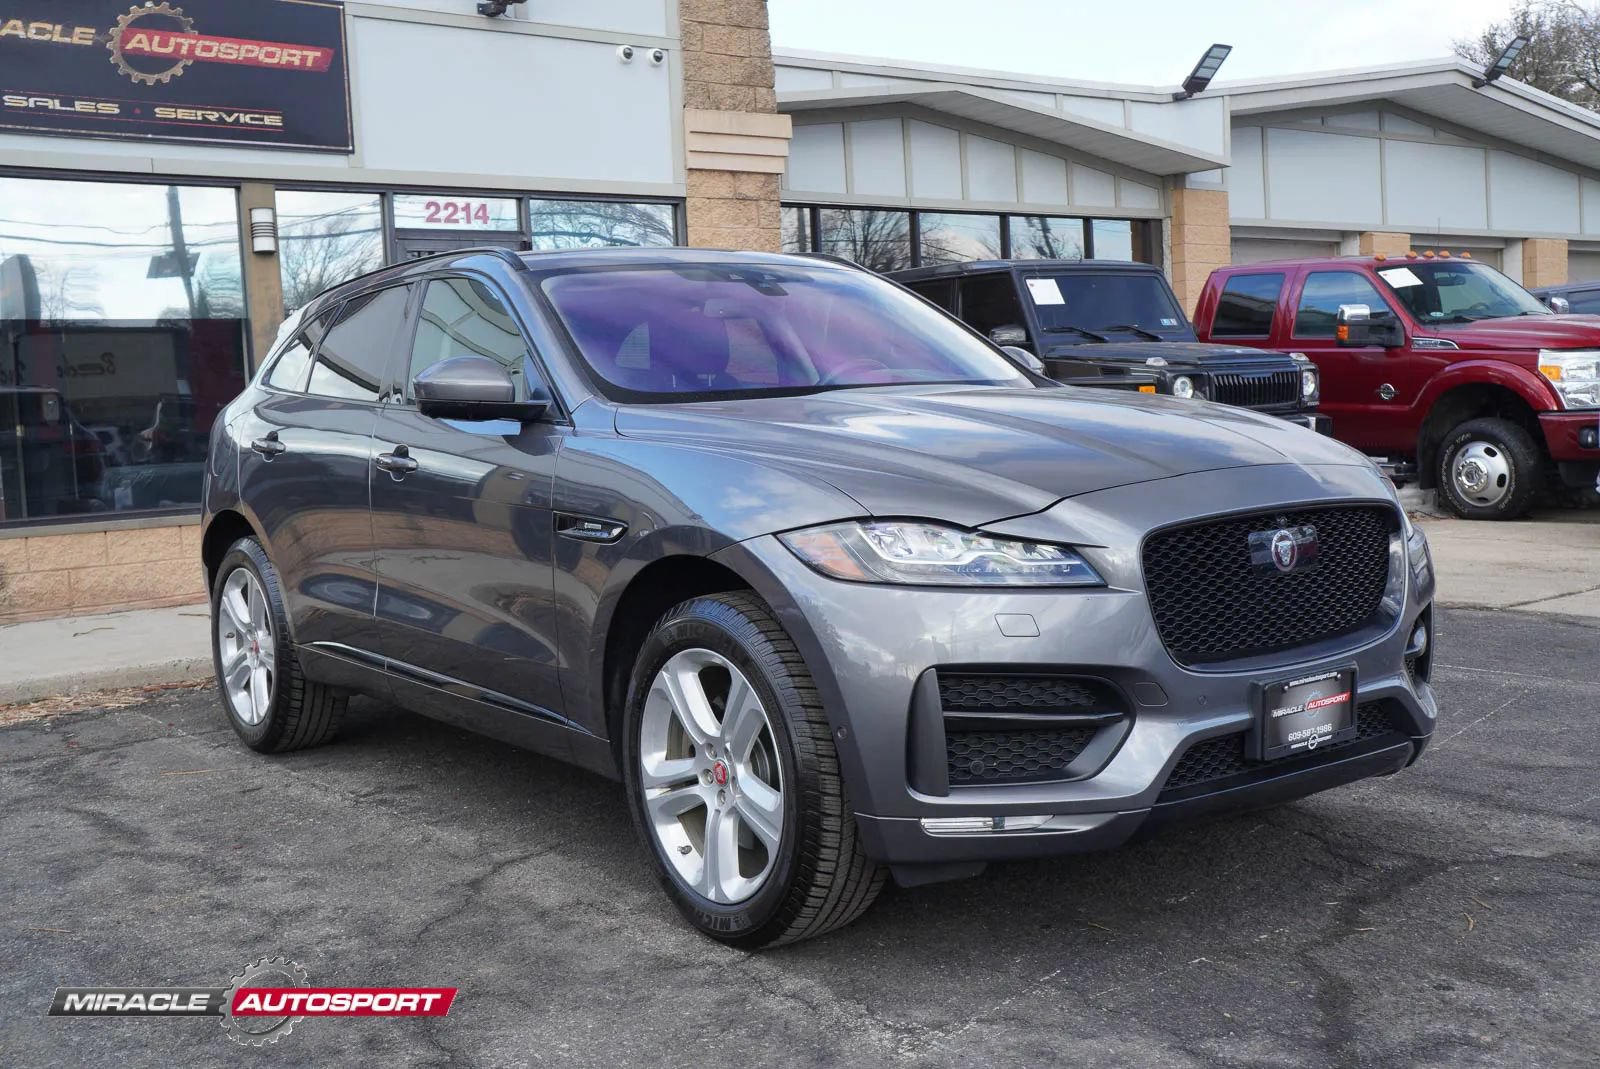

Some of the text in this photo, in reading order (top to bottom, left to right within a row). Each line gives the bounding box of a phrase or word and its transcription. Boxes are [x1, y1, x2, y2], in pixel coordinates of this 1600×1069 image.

[0, 19, 321, 67] ACLE AUTOSPORT
[2, 95, 283, 126] SALES SERVICE
[425, 201, 489, 225] 2214
[1272, 694, 1347, 718] MIRACLE AUTOSPORT
